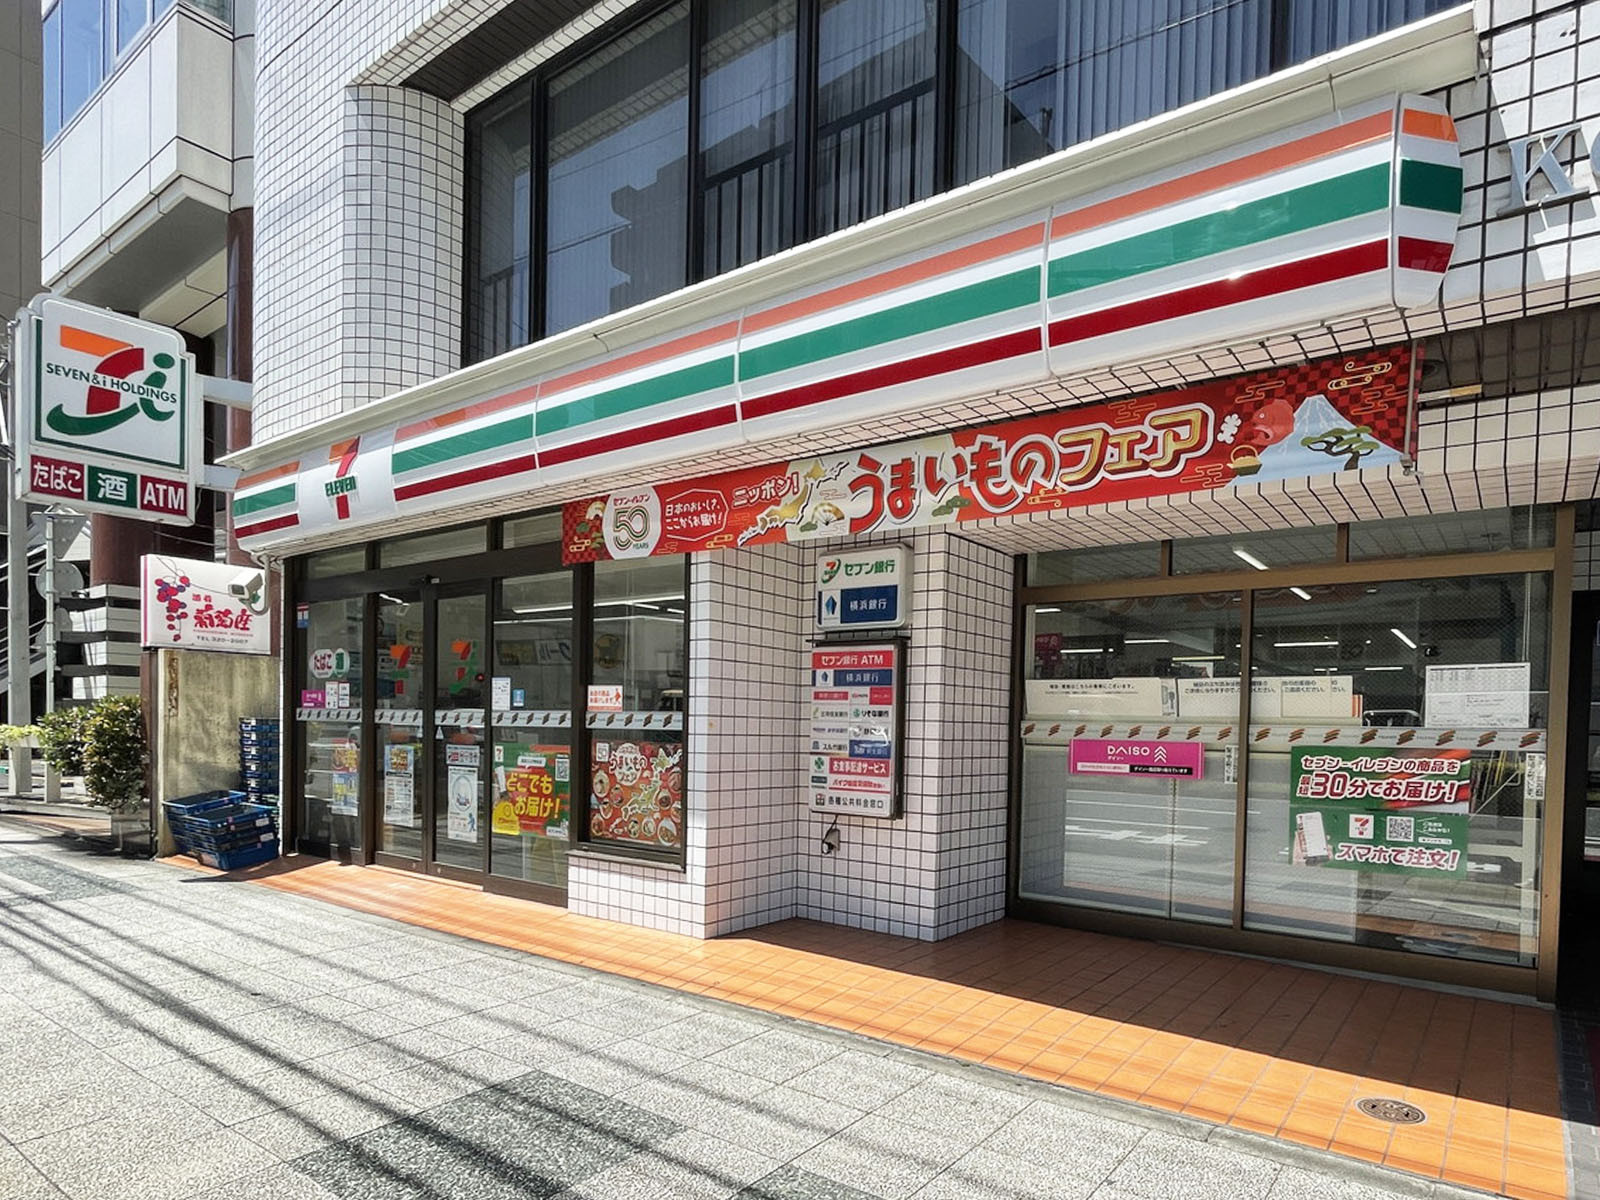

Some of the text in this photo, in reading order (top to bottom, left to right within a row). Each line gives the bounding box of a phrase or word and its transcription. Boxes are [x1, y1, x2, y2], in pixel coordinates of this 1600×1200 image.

[1496, 124, 1600, 217] K
[110, 378, 177, 404] HOLDINGS
[33, 462, 82, 494] たばこ
[97, 473, 128, 500] 酒
[143, 483, 185, 510] ATM
[844, 560, 895, 576] セブン銀行
[849, 599, 887, 611] 横浜銀行
[821, 655, 884, 666] セブン銀行 ATM
[506, 773, 553, 795] どこでも
[514, 797, 560, 819] お届け!
